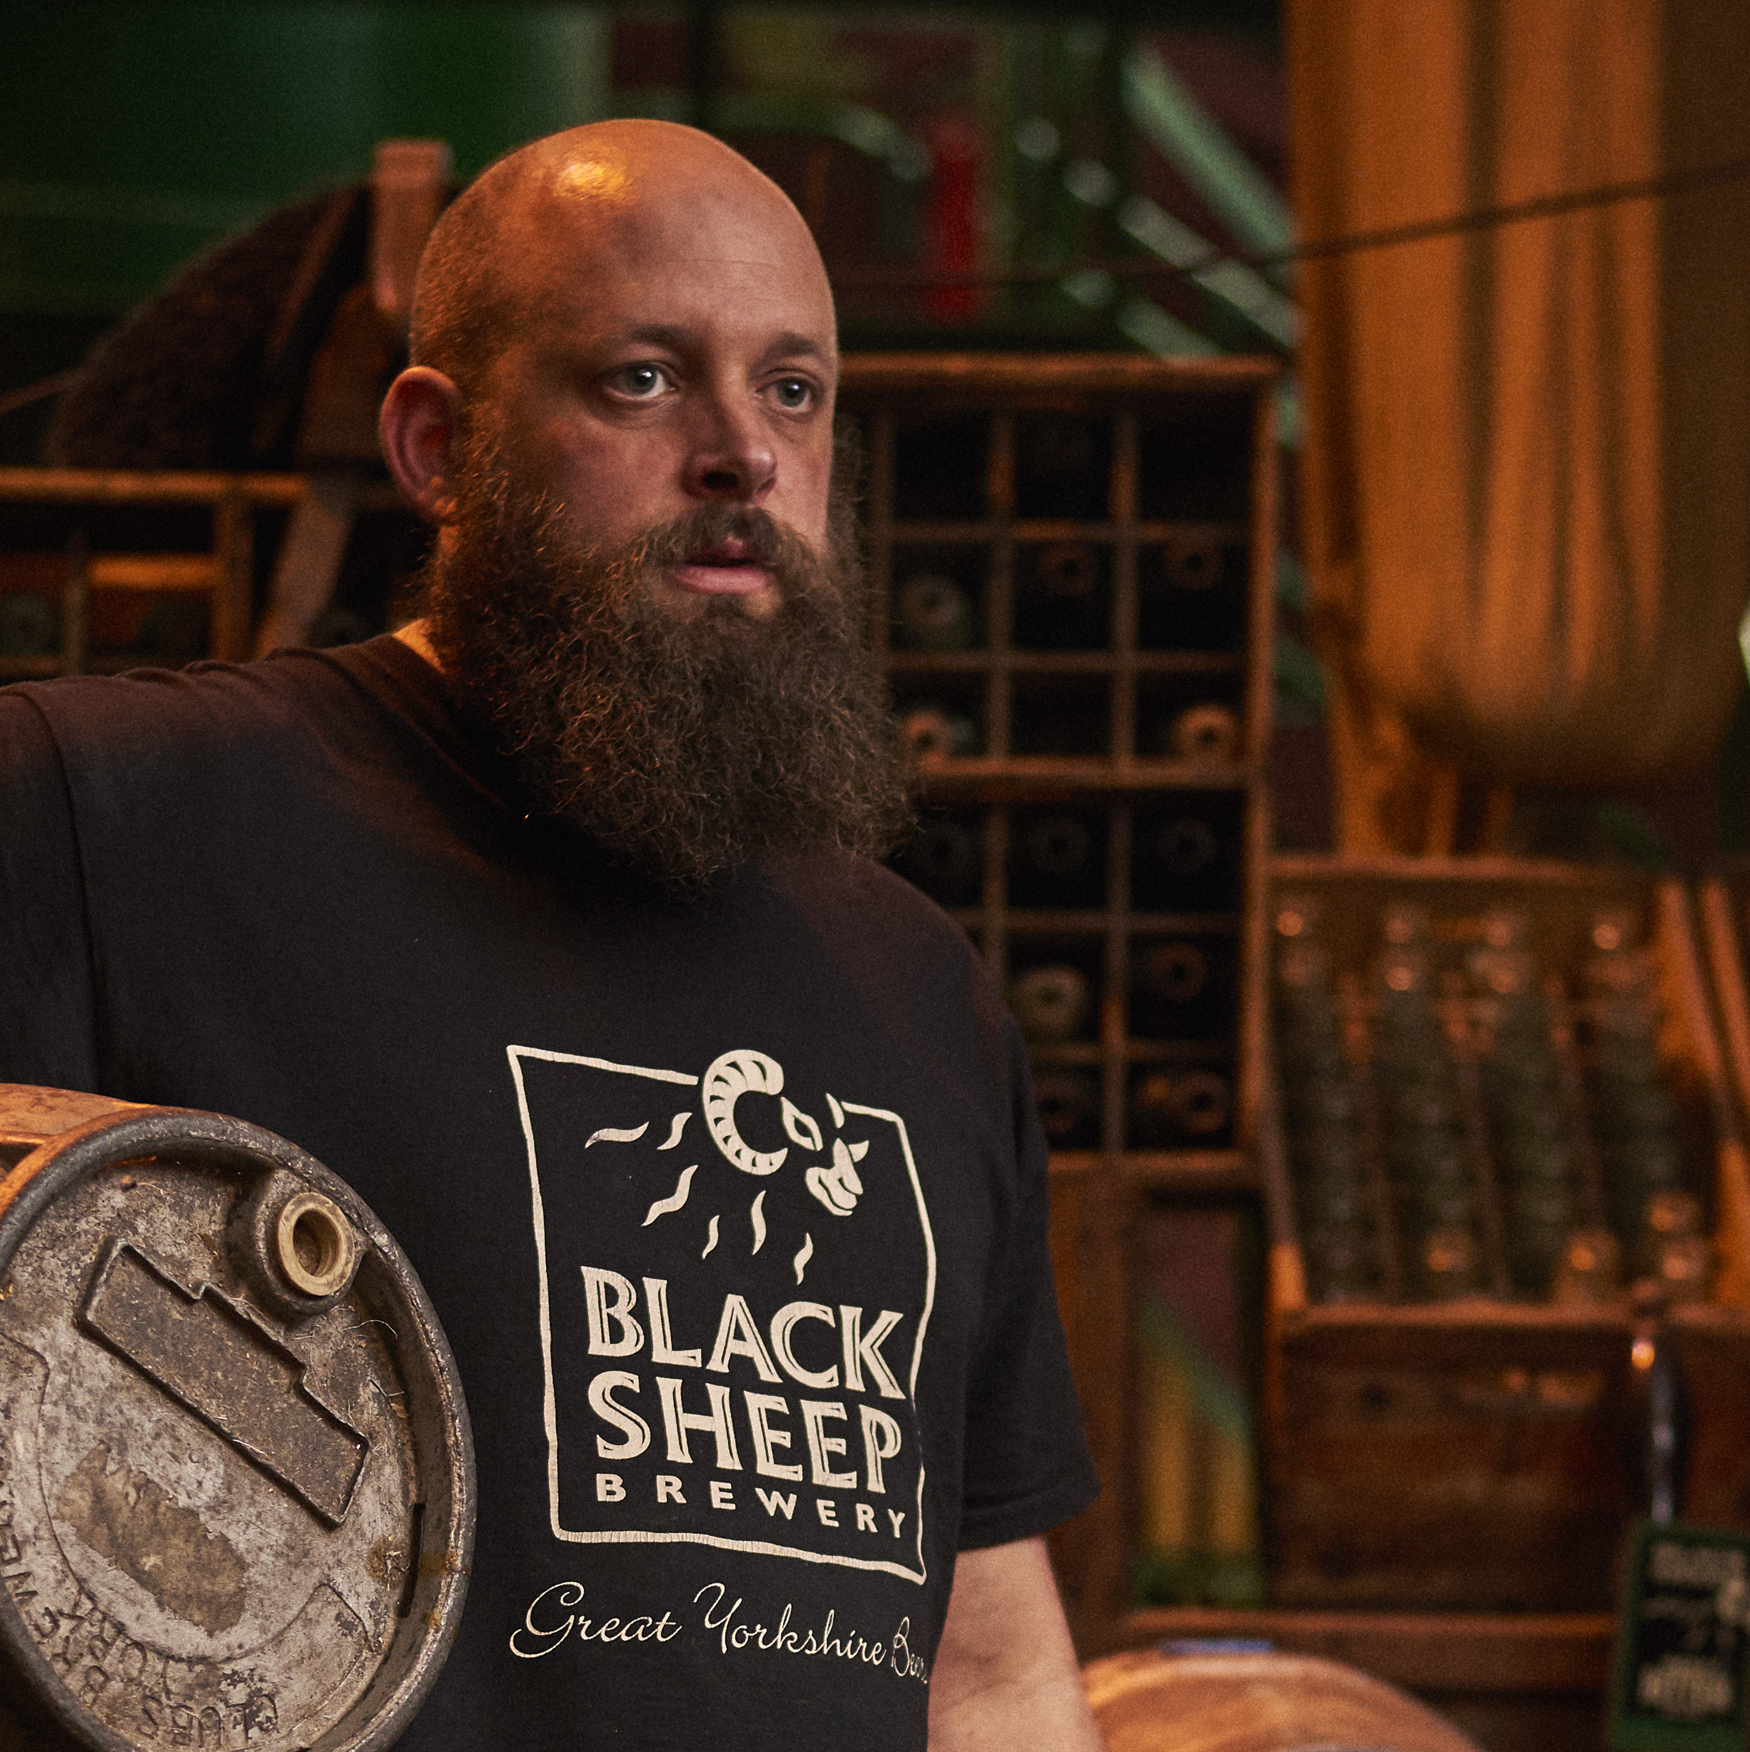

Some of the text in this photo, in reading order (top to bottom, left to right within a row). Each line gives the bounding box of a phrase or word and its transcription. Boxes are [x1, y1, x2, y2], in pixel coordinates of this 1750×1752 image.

[579, 1264, 907, 1401] BLACK
[585, 1370, 905, 1495] SHEEP
[594, 1471, 906, 1541] BREWERY
[508, 1580, 683, 1660] Great
[693, 1582, 888, 1663] Yorkshire
[136, 1693, 280, 1752] CLUBS
